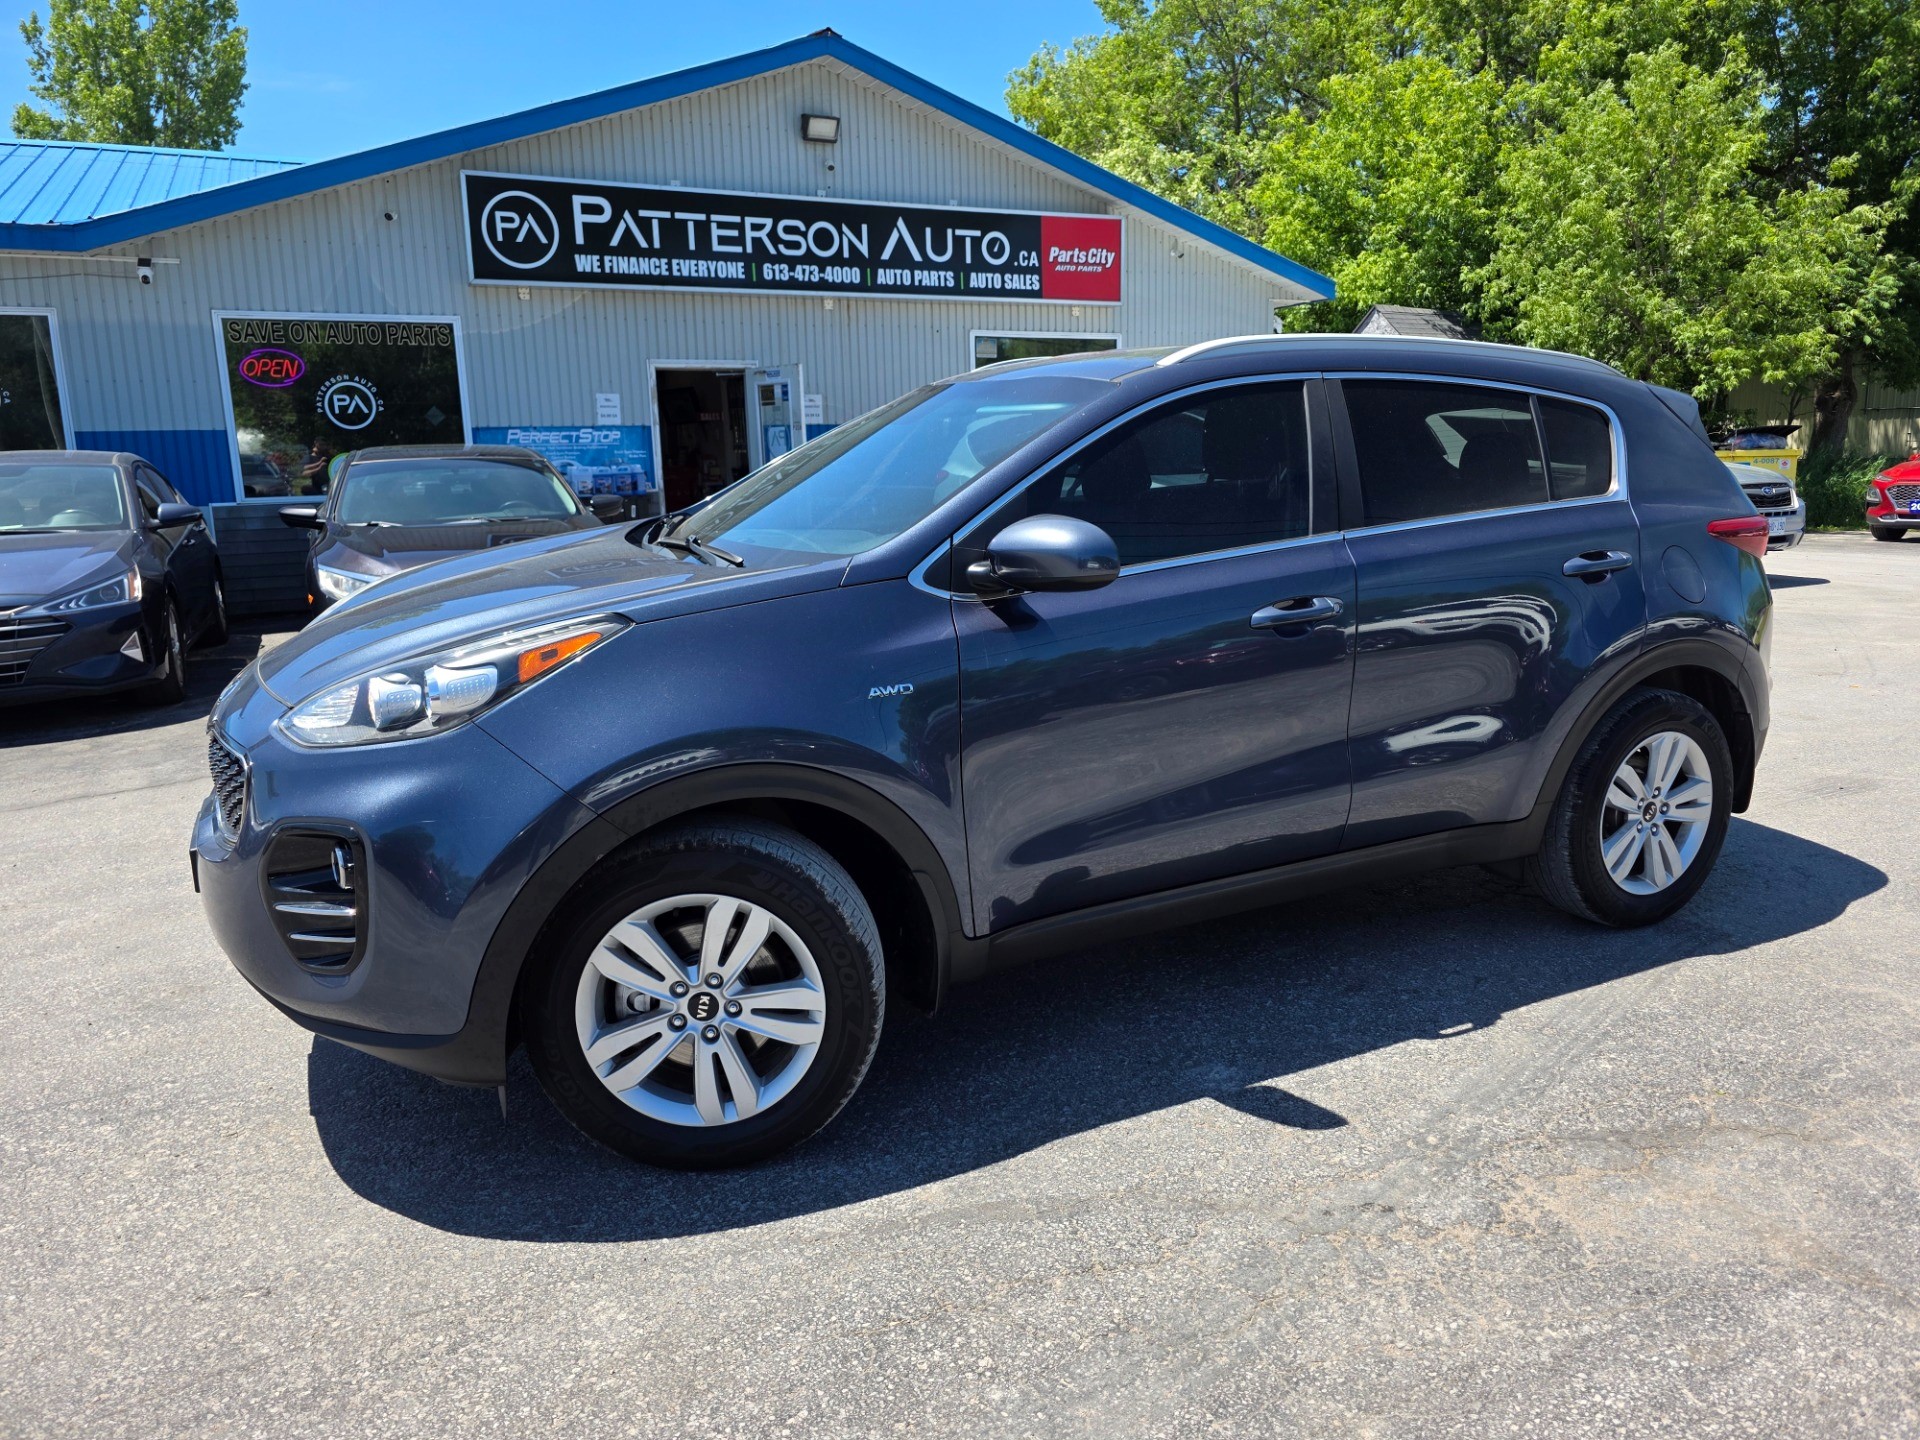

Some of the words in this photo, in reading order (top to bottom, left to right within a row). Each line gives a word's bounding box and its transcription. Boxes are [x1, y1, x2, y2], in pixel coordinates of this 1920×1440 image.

[572, 194, 869, 259] PATTERSON
[574, 254, 602, 273] WE
[604, 255, 671, 276] FINANCE
[672, 258, 745, 279] EVERYONE
[763, 262, 861, 284] 613-473-4000
[877, 269, 912, 286] AUTO
[914, 270, 955, 288] PARTS
[969, 272, 1001, 289] AUTO
[1004, 273, 1040, 291] SALES
[1055, 264, 1076, 272] AUTO
[1077, 265, 1103, 273] PARTS
[228, 320, 285, 344] SAVE
[290, 321, 320, 344] ON
[325, 322, 382, 346] AUTO
[386, 323, 451, 346] PARTS
[242, 358, 299, 378] OPEN
[316, 374, 350, 413] PATTERSON
[868, 683, 914, 700] AWD
[696, 995, 710, 1018] KIA
